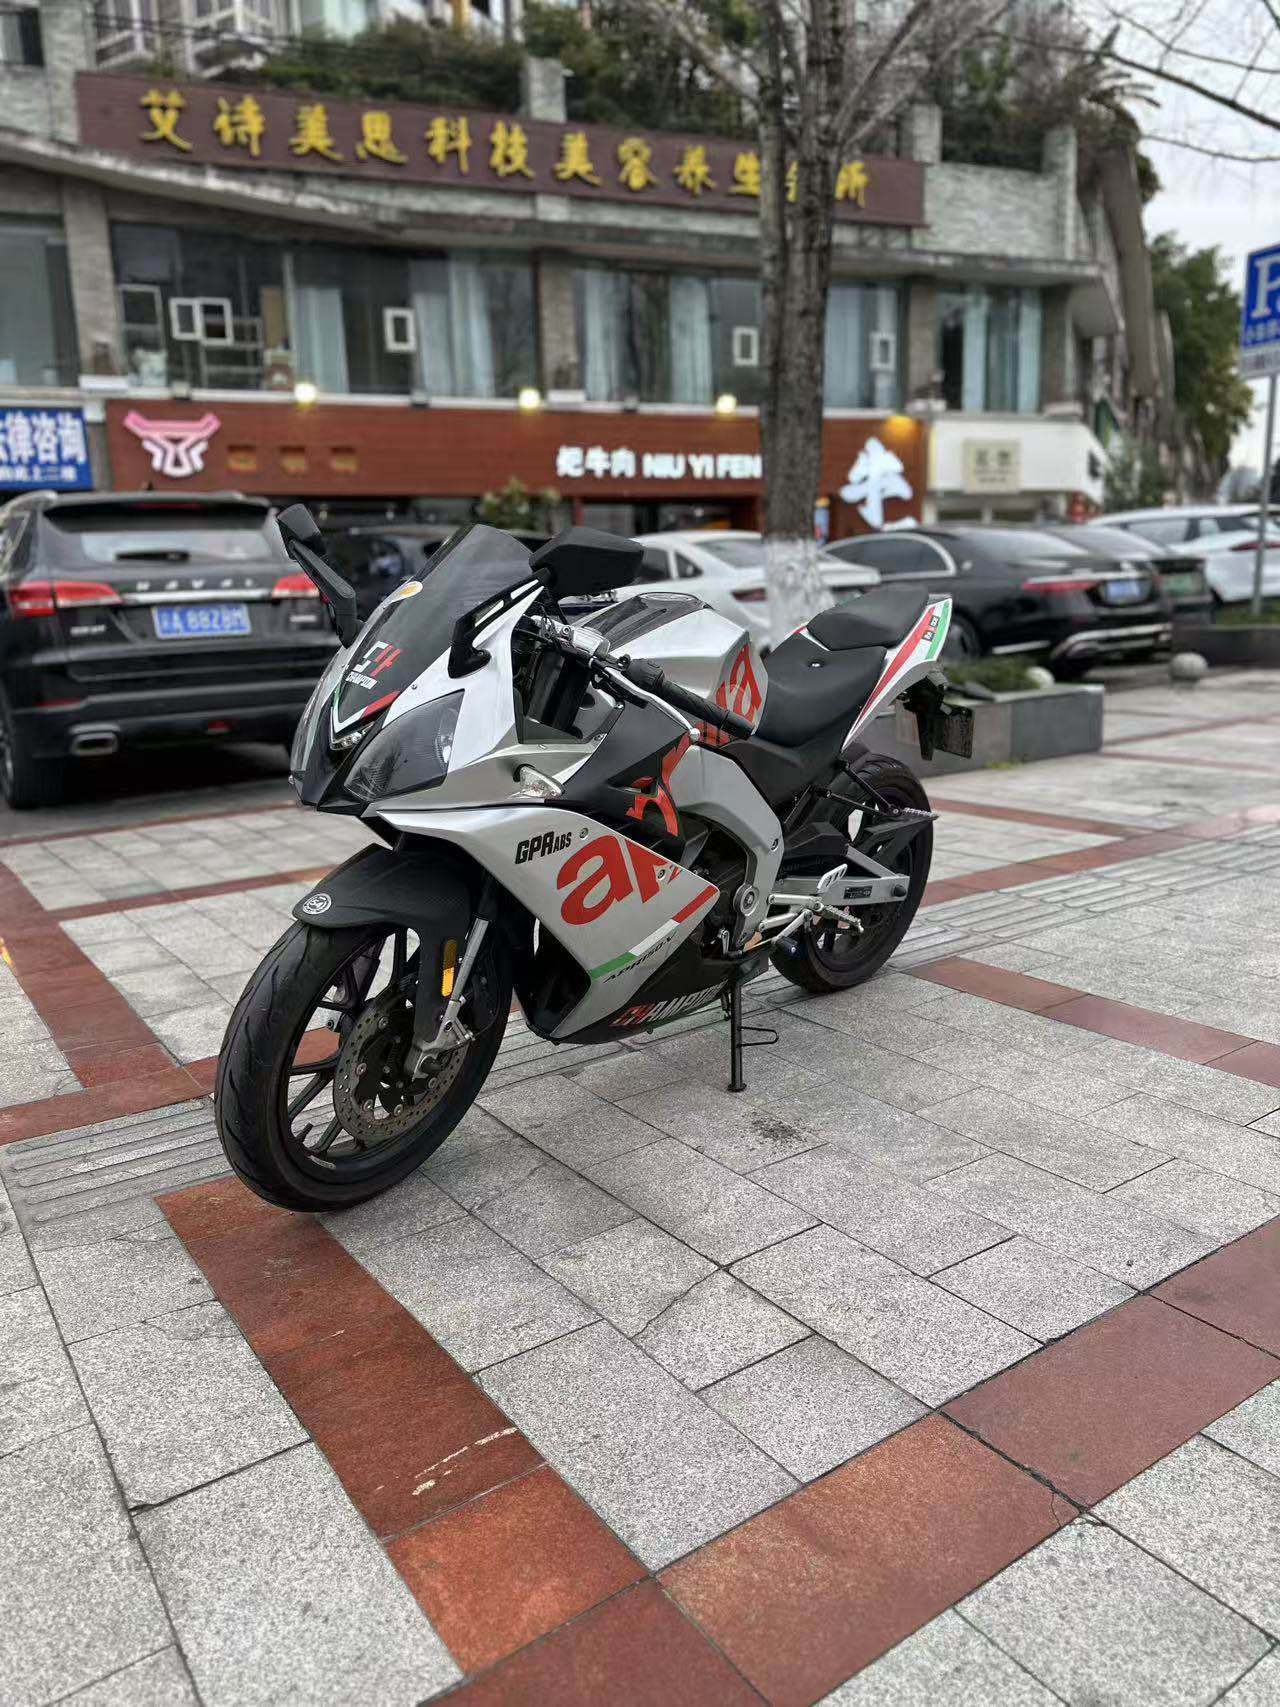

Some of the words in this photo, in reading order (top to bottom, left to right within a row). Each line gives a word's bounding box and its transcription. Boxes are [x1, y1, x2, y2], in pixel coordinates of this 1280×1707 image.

[642, 452, 687, 479] NIU
[688, 453, 715, 480] YI
[716, 454, 763, 480] FEN
